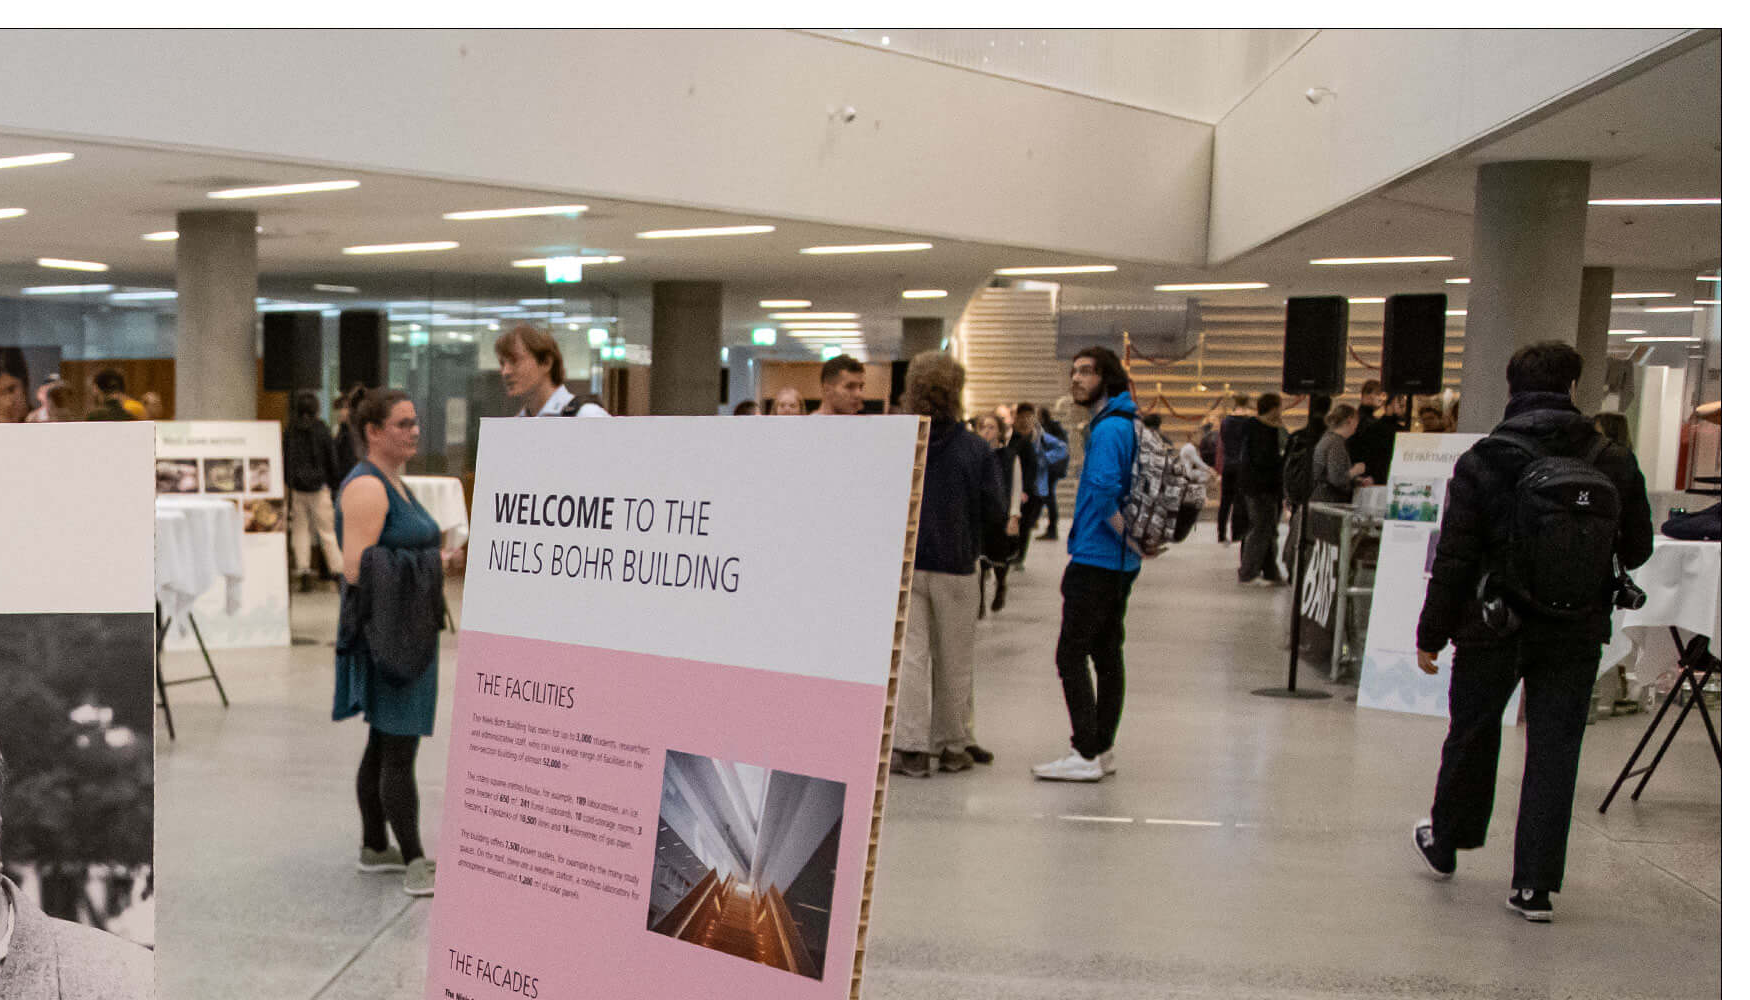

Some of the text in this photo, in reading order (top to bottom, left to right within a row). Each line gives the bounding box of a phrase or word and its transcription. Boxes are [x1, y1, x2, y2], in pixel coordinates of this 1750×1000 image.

[495, 492, 711, 536] WELCOME TO THE
[488, 539, 740, 593] NIELS BOHR BUILDING
[476, 671, 576, 709] THE FACILITIES
[575, 732, 592, 745] 3,000
[542, 756, 561, 770] 52,000
[499, 792, 509, 802] 650
[504, 839, 520, 853] 7,500
[449, 948, 539, 999] THE FACADES
[445, 987, 454, 998] The
